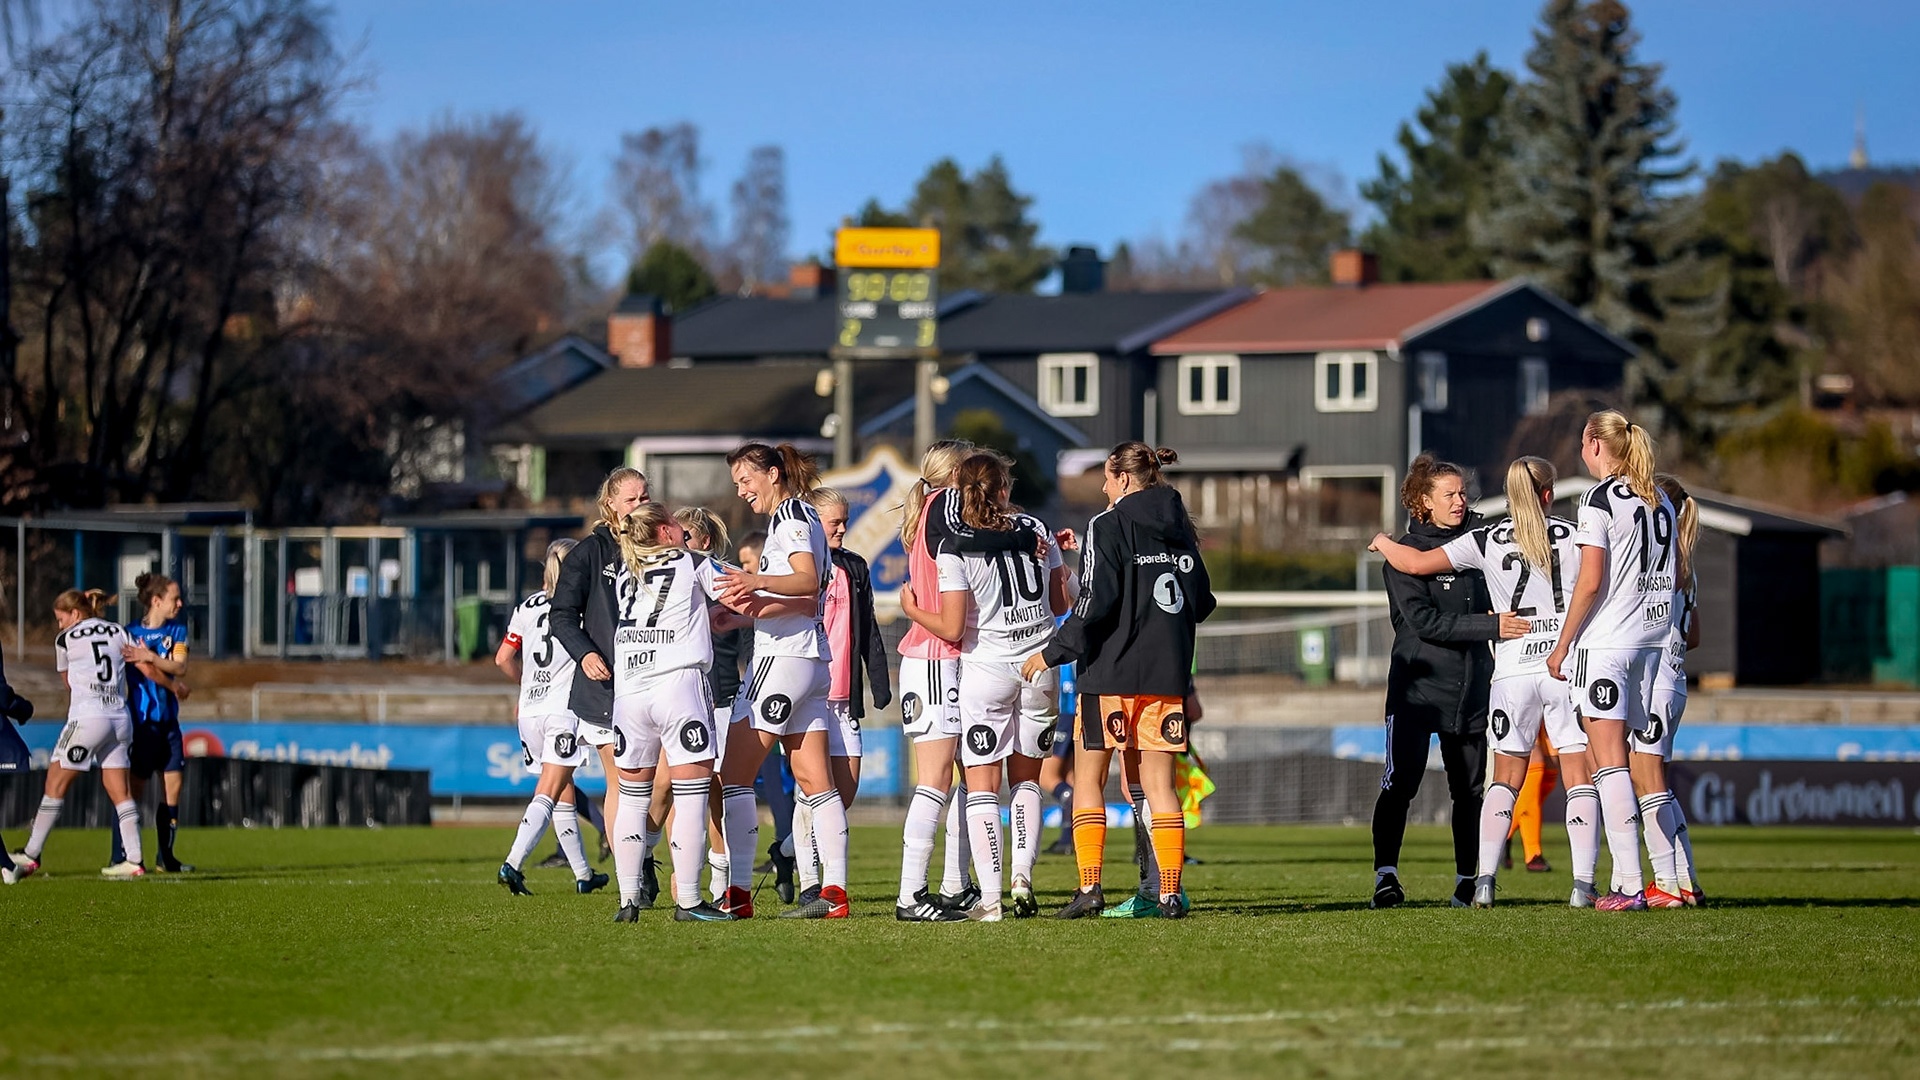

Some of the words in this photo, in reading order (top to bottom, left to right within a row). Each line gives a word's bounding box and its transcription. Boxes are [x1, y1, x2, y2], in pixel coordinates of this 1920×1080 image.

[1633, 505, 1672, 573] 19
[1502, 551, 1566, 617] 21
[1003, 603, 1044, 626] KANUTTE
[1530, 618, 1559, 634] UTNES
[1646, 601, 1670, 621] MOT
[533, 612, 554, 668] 3
[1012, 623, 1043, 642] MOT
[1525, 639, 1556, 655] MOT
[91, 640, 113, 683] 5
[627, 649, 657, 670] MOT
[1016, 803, 1026, 849] RAMIRENT
[984, 820, 1001, 873] RAMIRENT
